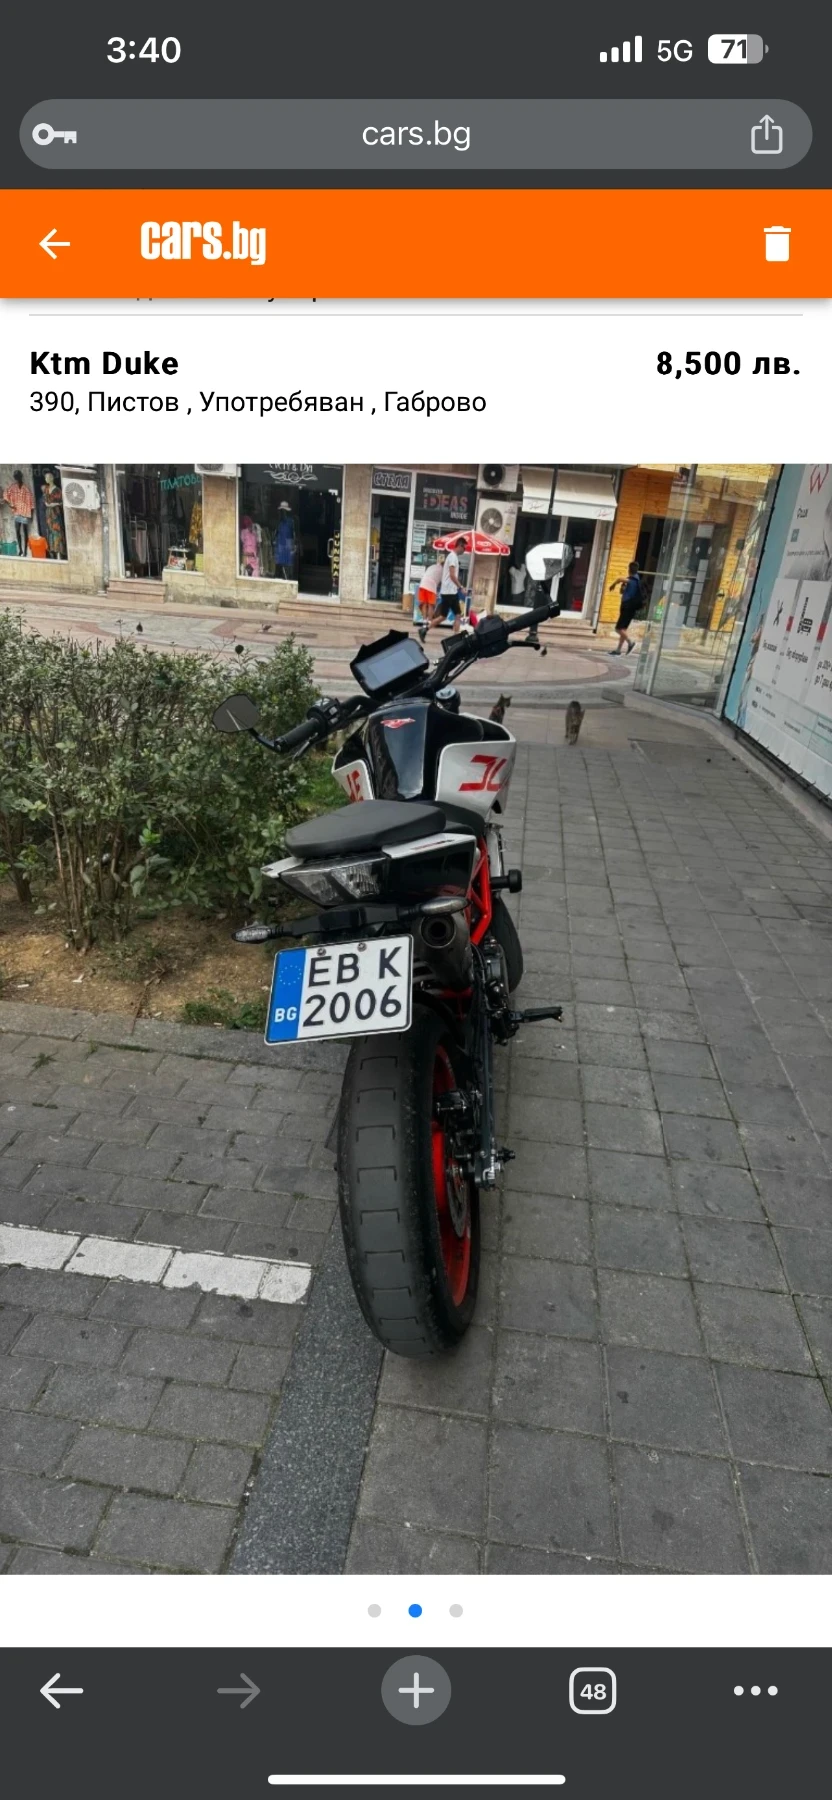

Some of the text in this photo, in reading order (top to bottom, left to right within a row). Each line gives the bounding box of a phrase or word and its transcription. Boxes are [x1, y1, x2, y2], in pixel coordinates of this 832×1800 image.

[106, 37, 182, 64] 3:40
[657, 39, 693, 63] 5G
[721, 39, 747, 60] 71
[362, 119, 471, 152] cars.bg
[140, 220, 267, 266] cars.bg
[30, 351, 179, 376] Ktm Duke
[656, 350, 800, 380] 8,500 лв.
[30, 391, 80, 416] 390,
[88, 391, 179, 412] Пистов
[199, 389, 363, 418] Употребяван
[385, 389, 487, 418] Габрово
[308, 946, 402, 988] EB K
[274, 1006, 298, 1023] BG
[302, 985, 402, 1028] 2006
[579, 1683, 607, 1701] 48
